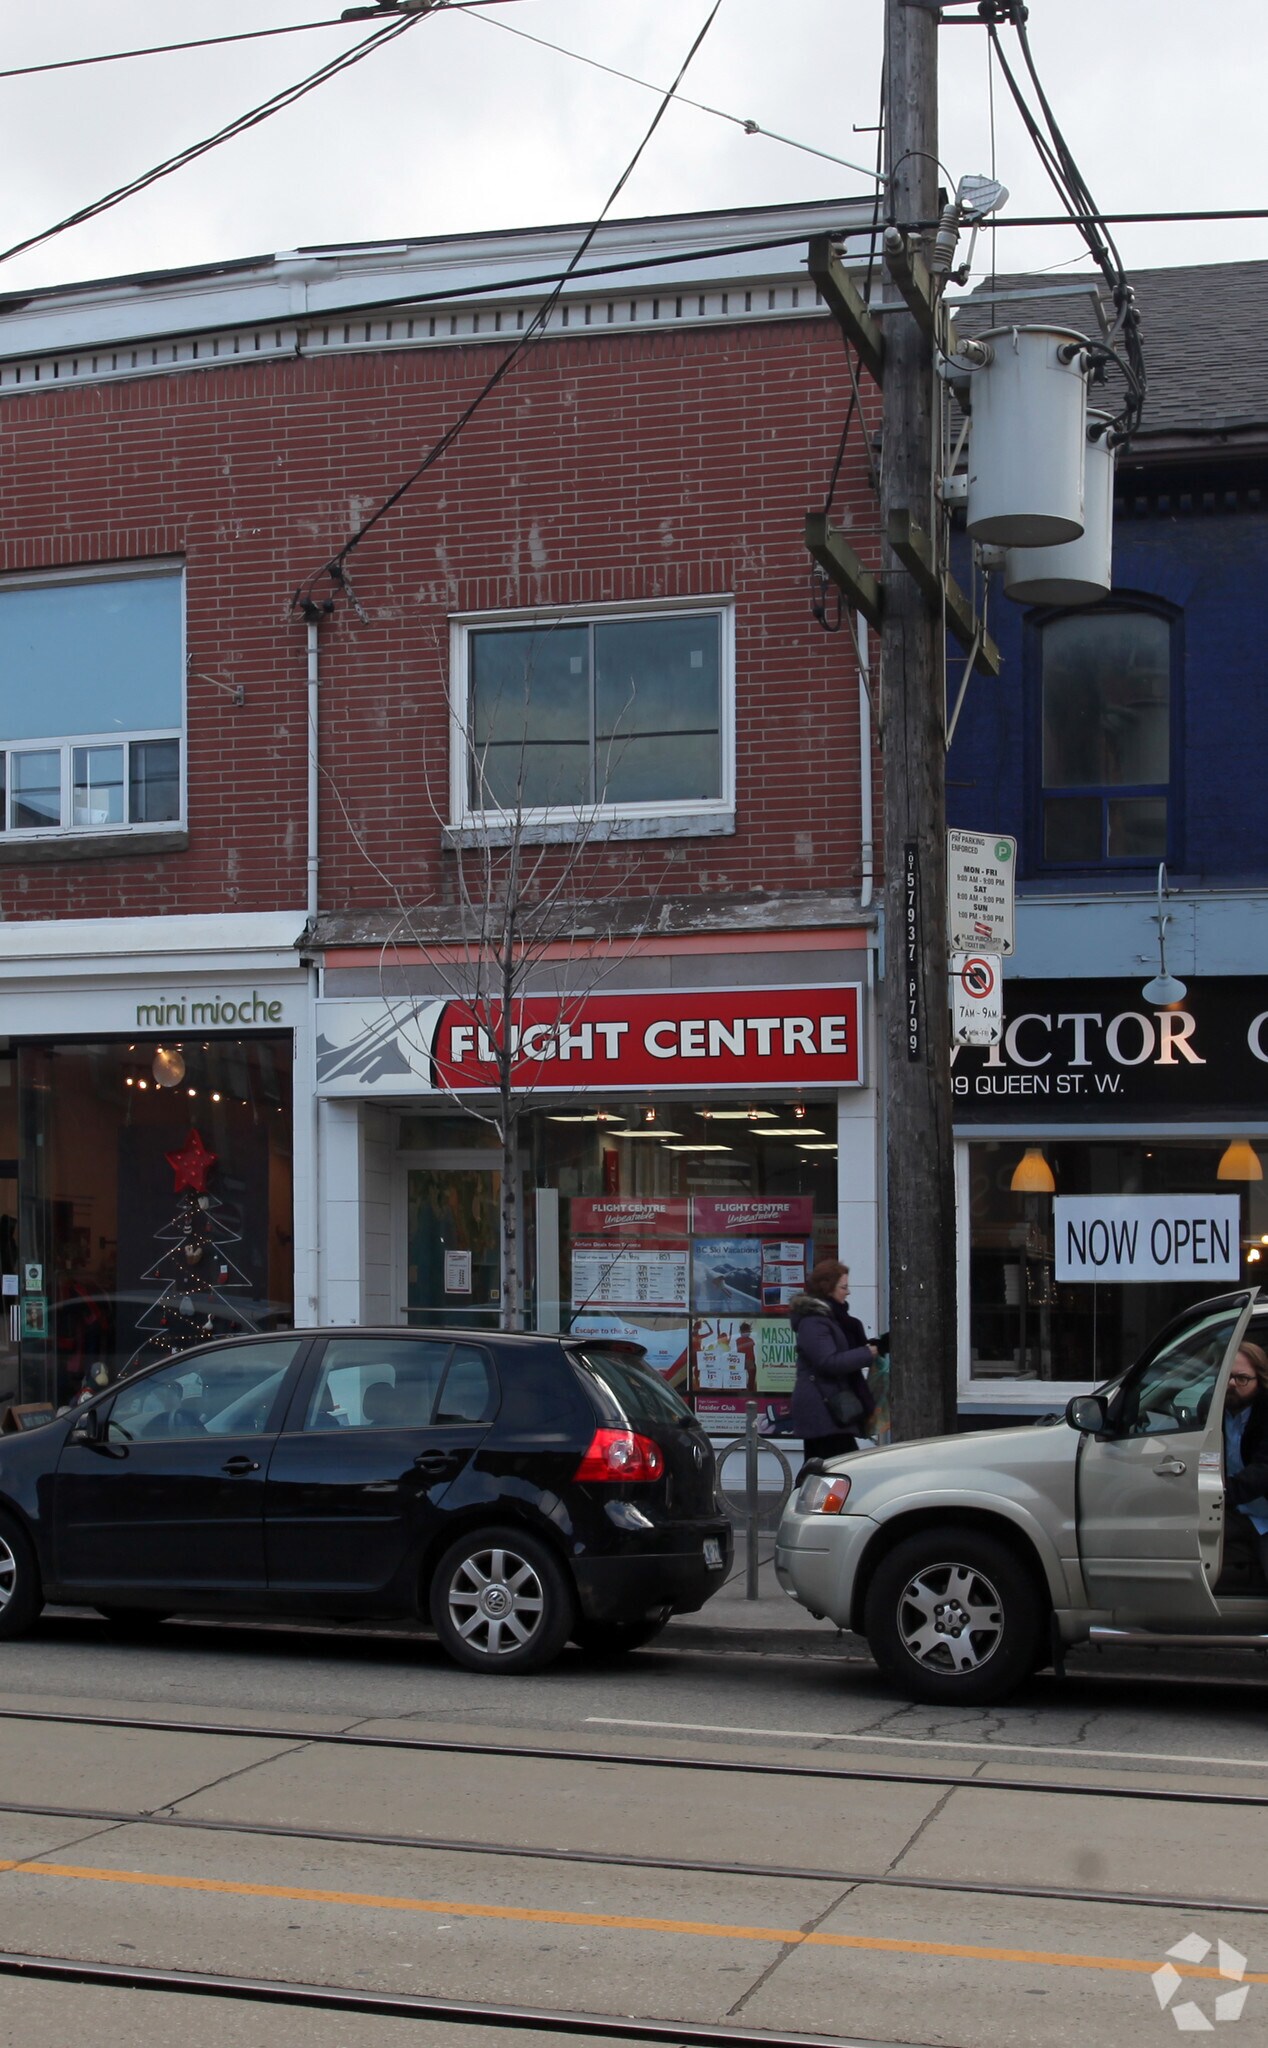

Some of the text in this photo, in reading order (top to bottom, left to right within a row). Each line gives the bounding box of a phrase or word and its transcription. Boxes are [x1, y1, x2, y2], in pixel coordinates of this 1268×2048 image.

[962, 836, 985, 846] PARKING
[952, 844, 978, 854] ENFORCED
[964, 866, 980, 874] MON
[957, 874, 968, 882] 9:00
[983, 877, 994, 885] 9:00
[983, 895, 994, 903] 9:00
[136, 990, 283, 1026] mini mioche
[960, 1006, 975, 1018] 7AM
[982, 1007, 997, 1018] 9AM
[450, 1014, 848, 1064] FLIGHT CENTRE
[950, 1011, 1207, 1067] CTOR
[975, 1074, 1050, 1094] QUEEN
[1056, 1074, 1088, 1093] ST.
[1095, 1074, 1124, 1093] W.
[592, 1204, 666, 1213] FLIGHT CENTRE
[714, 1203, 790, 1212] FLIGHT CENTRE
[1067, 1218, 1230, 1266] NOW OPEN
[762, 1328, 794, 1344] MASSI
